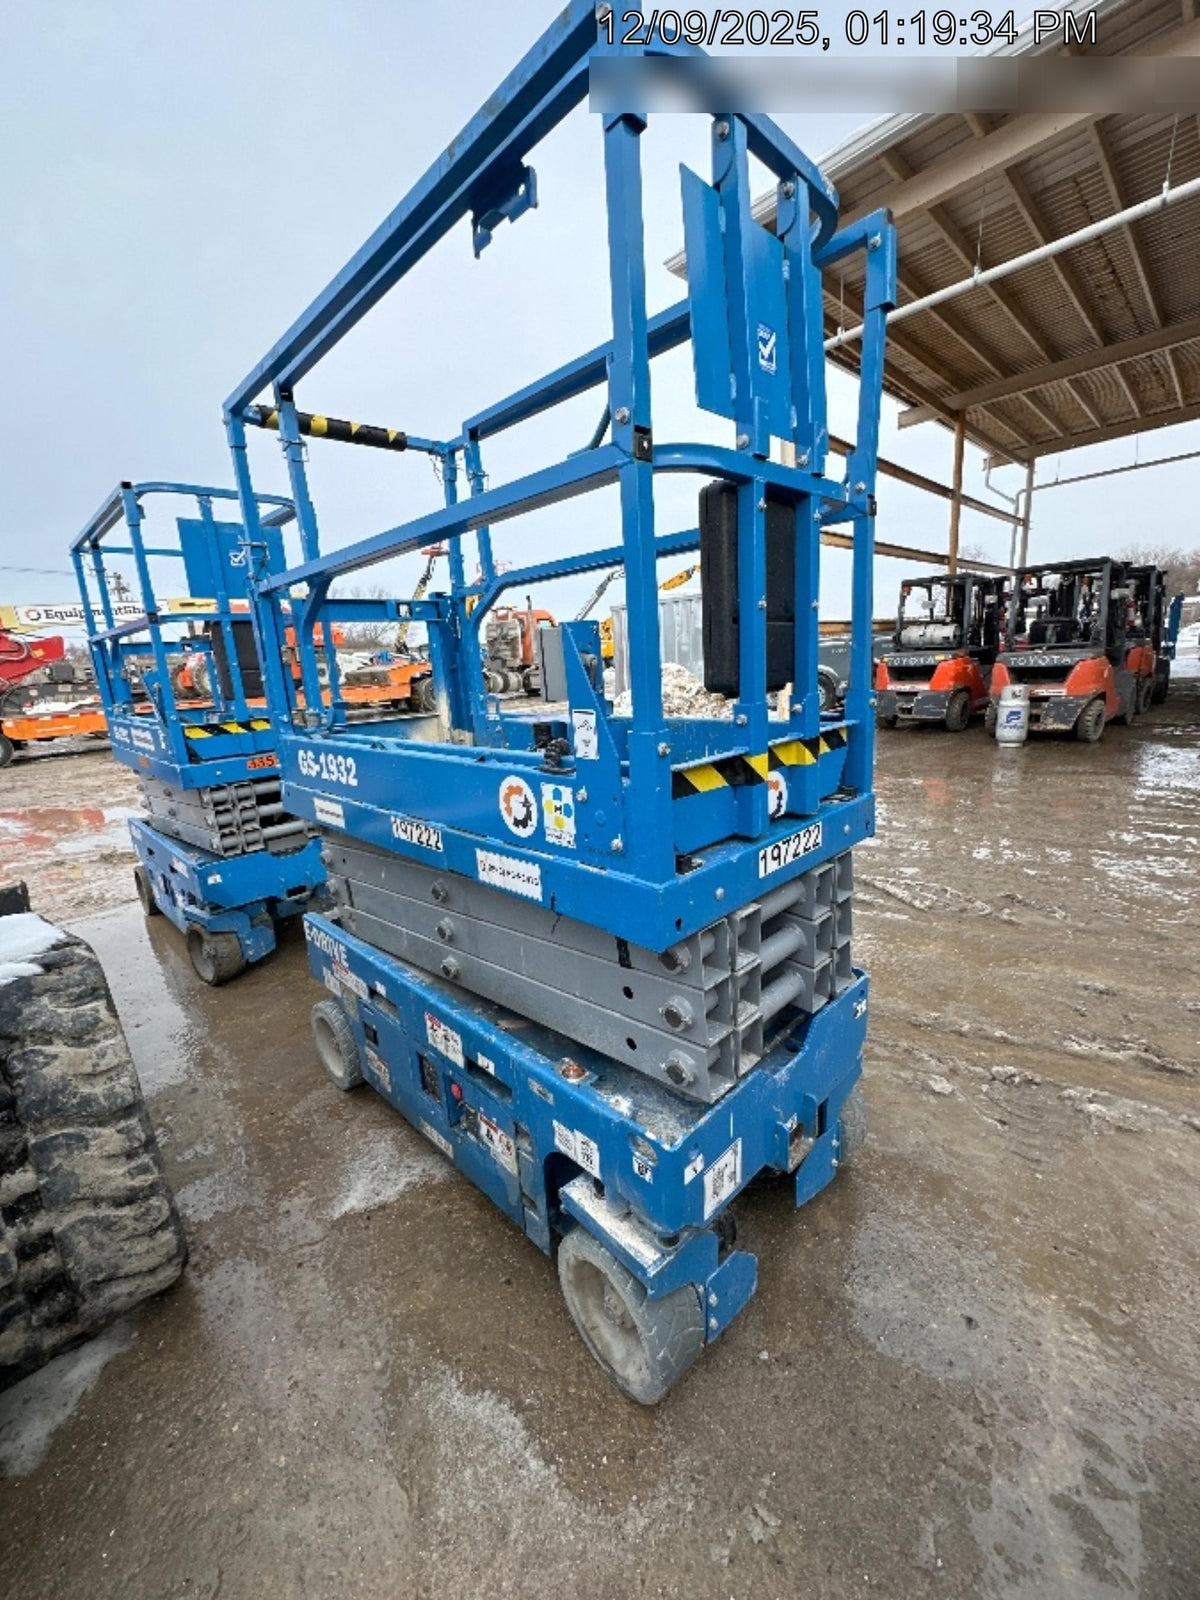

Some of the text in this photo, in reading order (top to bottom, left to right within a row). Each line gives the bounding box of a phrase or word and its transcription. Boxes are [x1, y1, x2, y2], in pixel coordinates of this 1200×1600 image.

[887, 654, 936, 666] TOYOTA
[1010, 653, 1072, 666] TOYOTA
[298, 749, 358, 787] GS-1932
[759, 824, 821, 875] 197222
